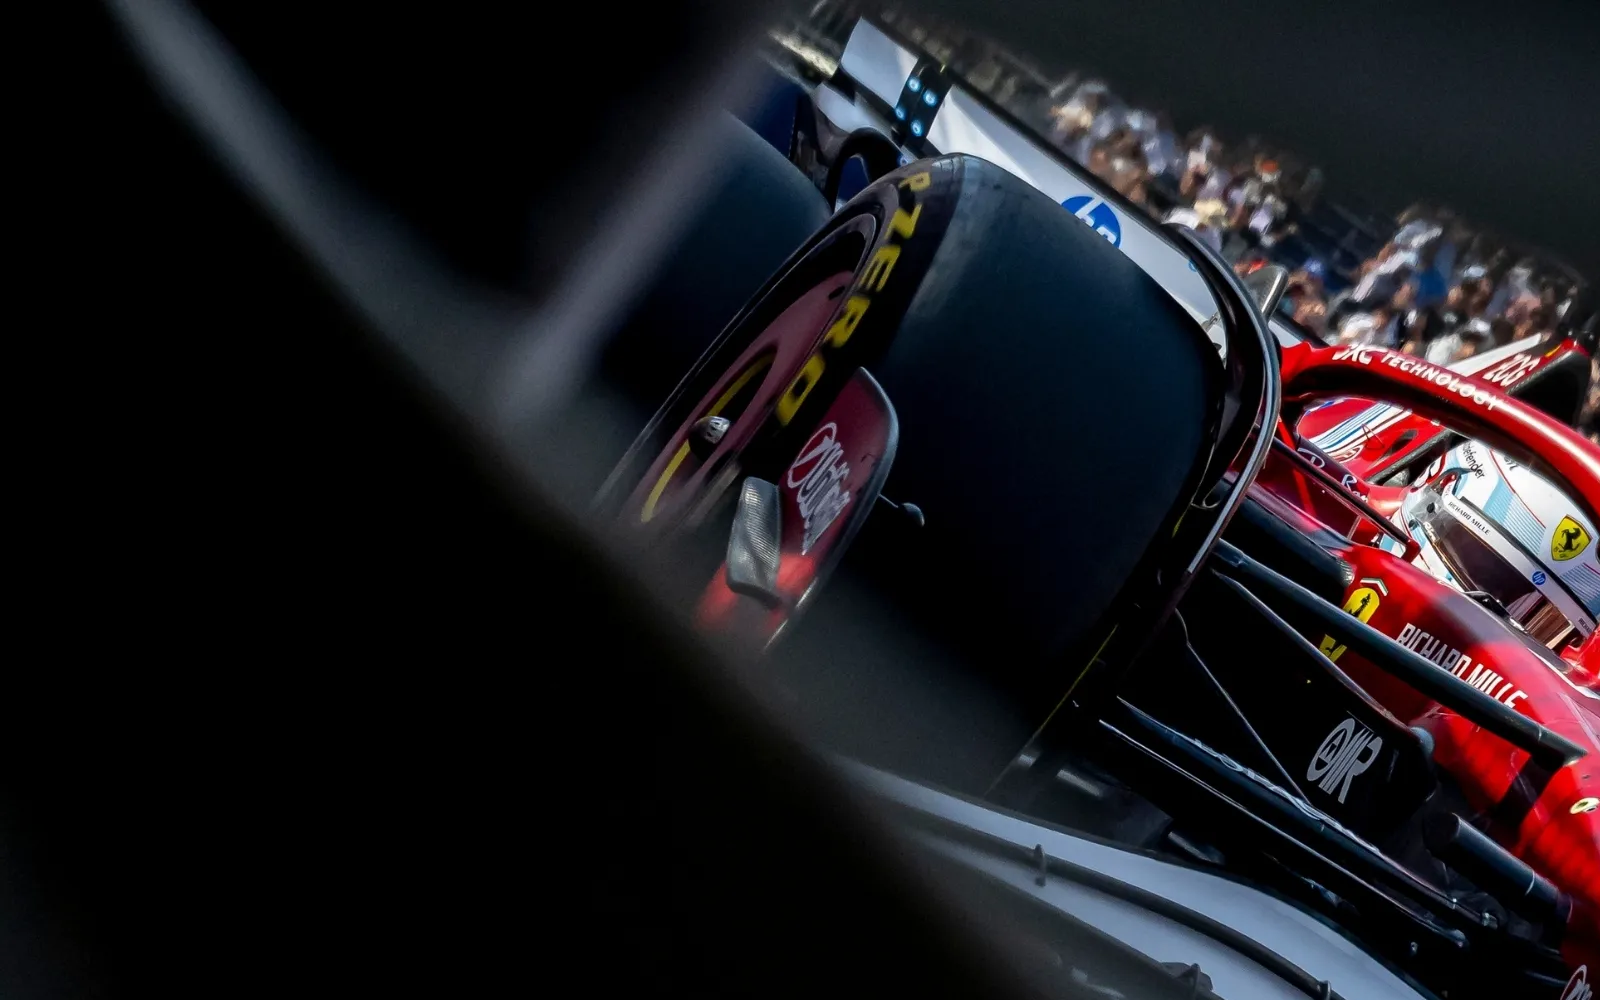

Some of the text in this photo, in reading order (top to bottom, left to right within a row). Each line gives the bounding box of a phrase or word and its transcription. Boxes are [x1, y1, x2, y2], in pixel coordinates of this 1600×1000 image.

[776, 203, 922, 427] ZERO
[1380, 351, 1503, 411] TECHNOLOGY
[1470, 518, 1491, 536] MILLE
[1396, 622, 1529, 710] RICHARD MILLE
